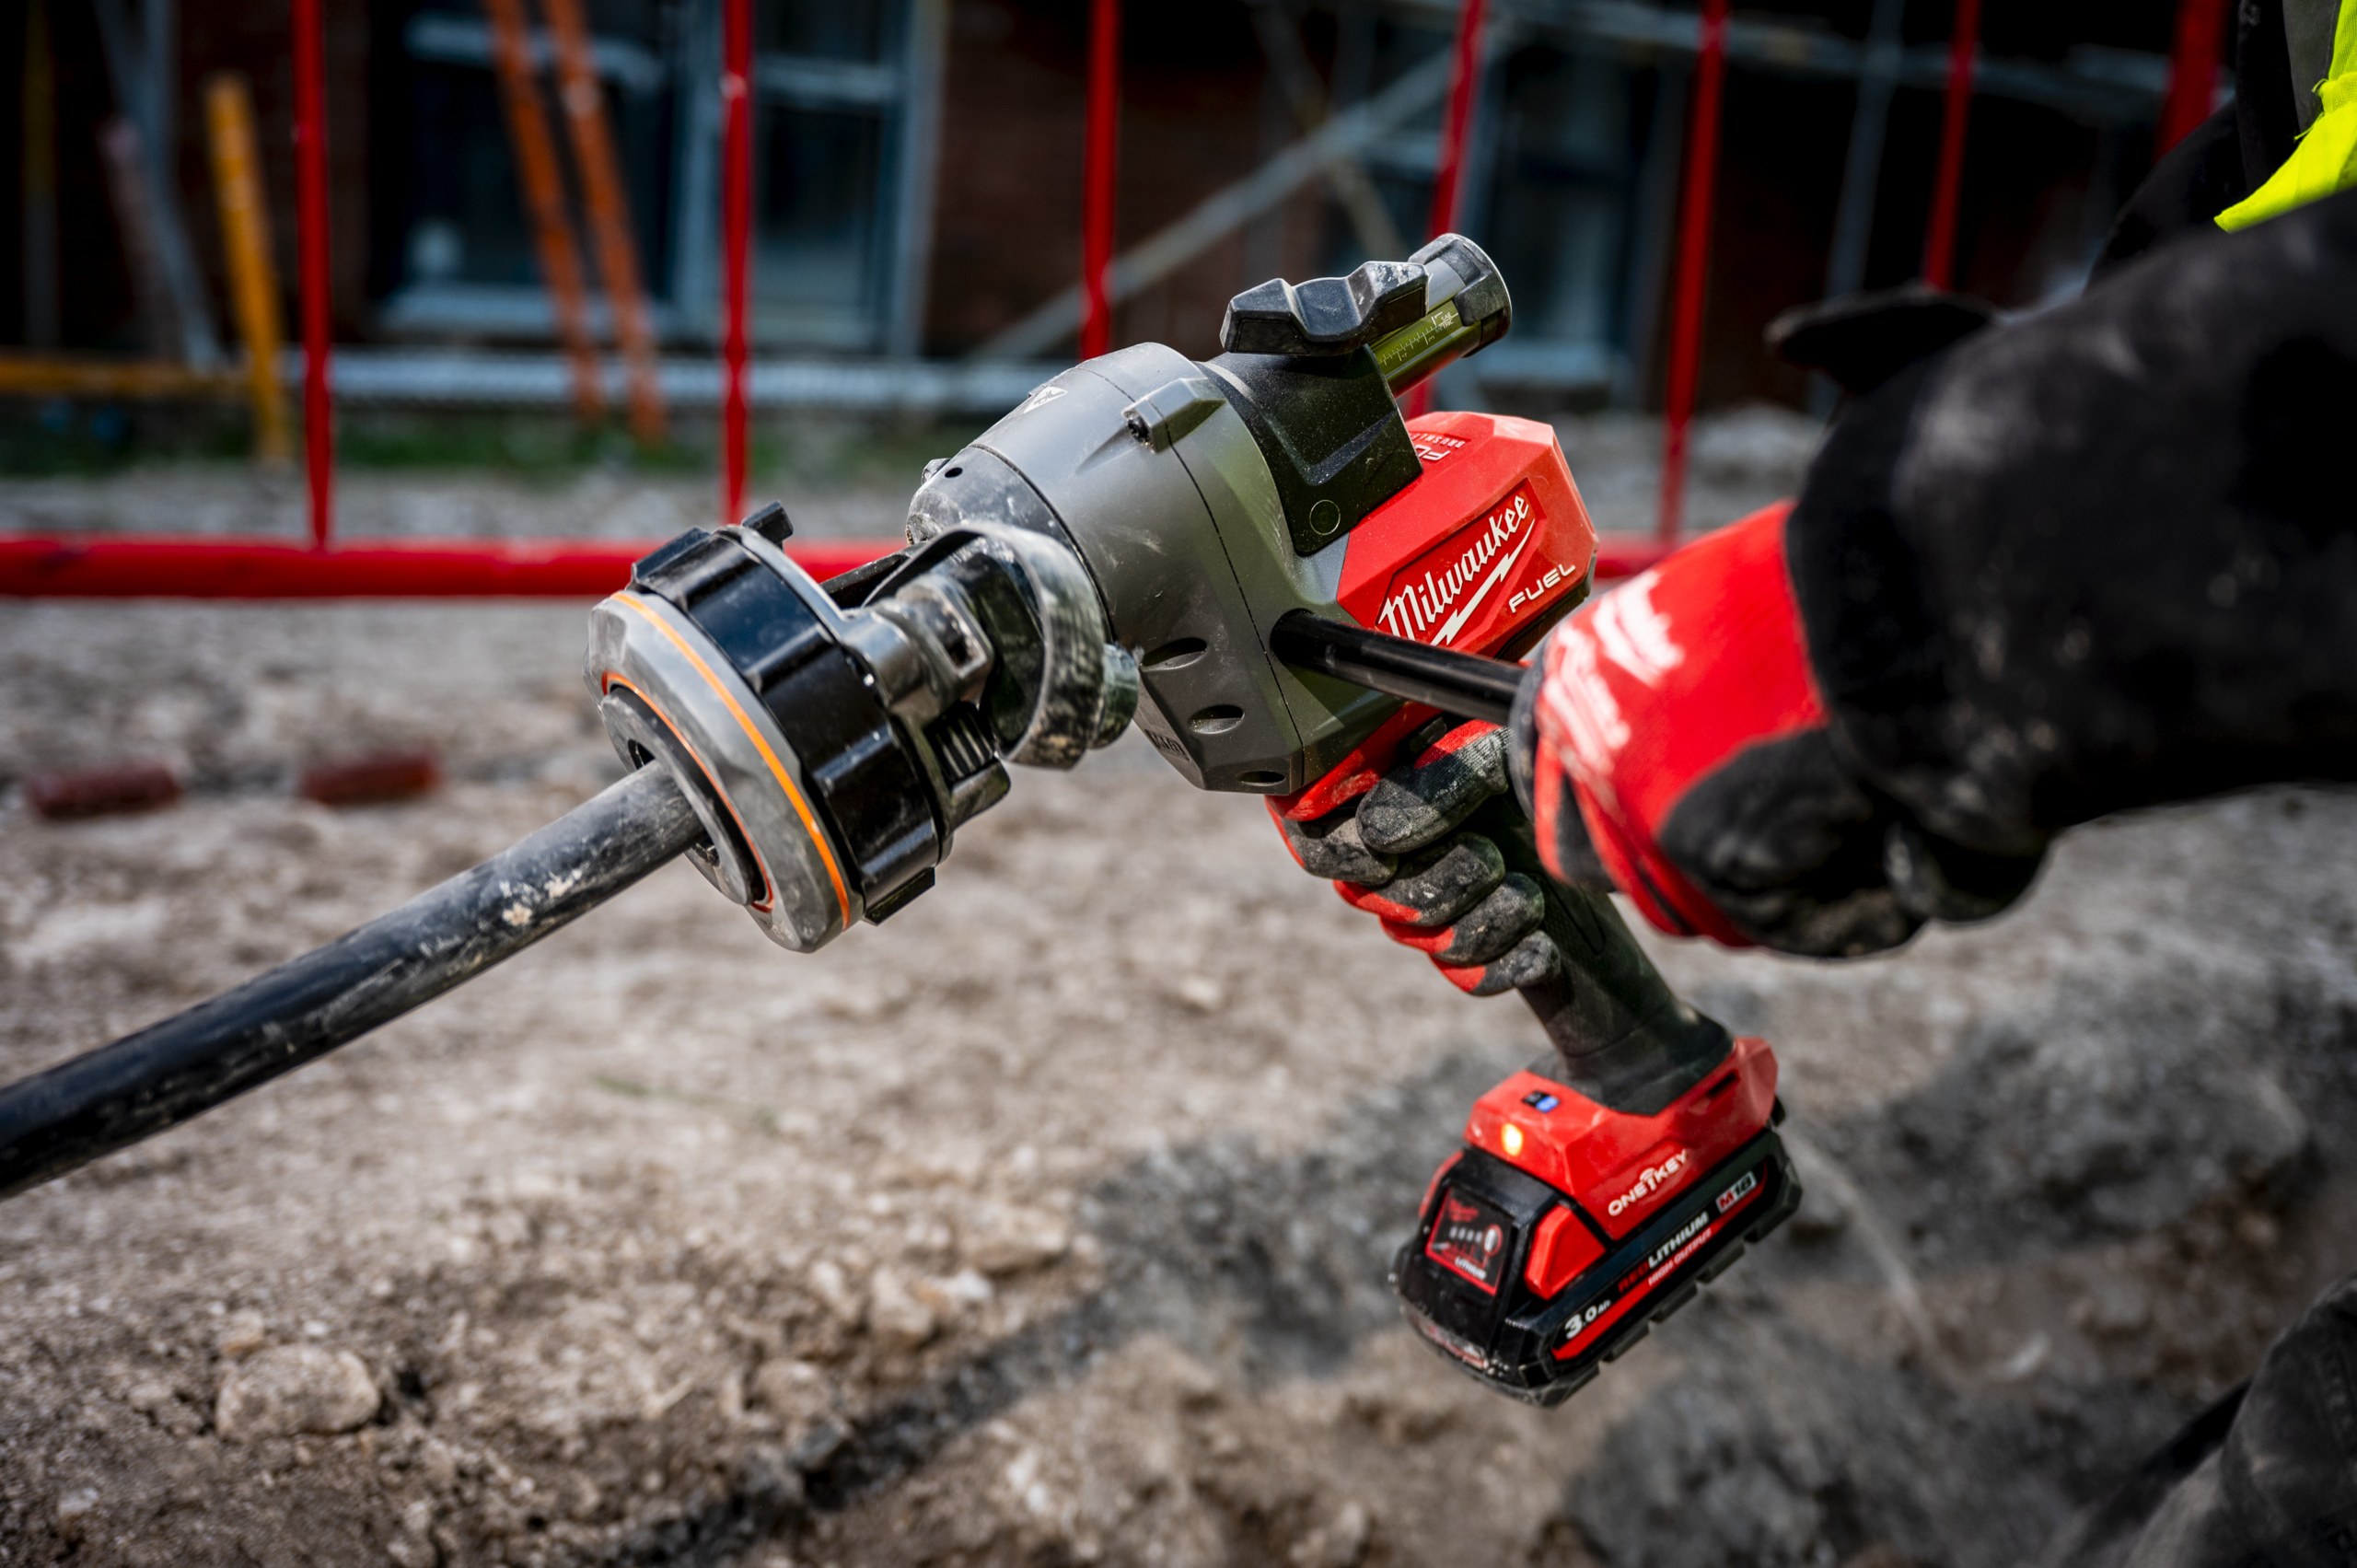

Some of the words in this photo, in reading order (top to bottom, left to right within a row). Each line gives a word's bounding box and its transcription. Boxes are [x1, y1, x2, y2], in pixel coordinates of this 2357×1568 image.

[1377, 495, 1529, 642] Milwaukee
[1508, 563, 1576, 614] FUEL
[1717, 1173, 1755, 1211] M18
[1674, 1227, 1713, 1267] OUTPUT
